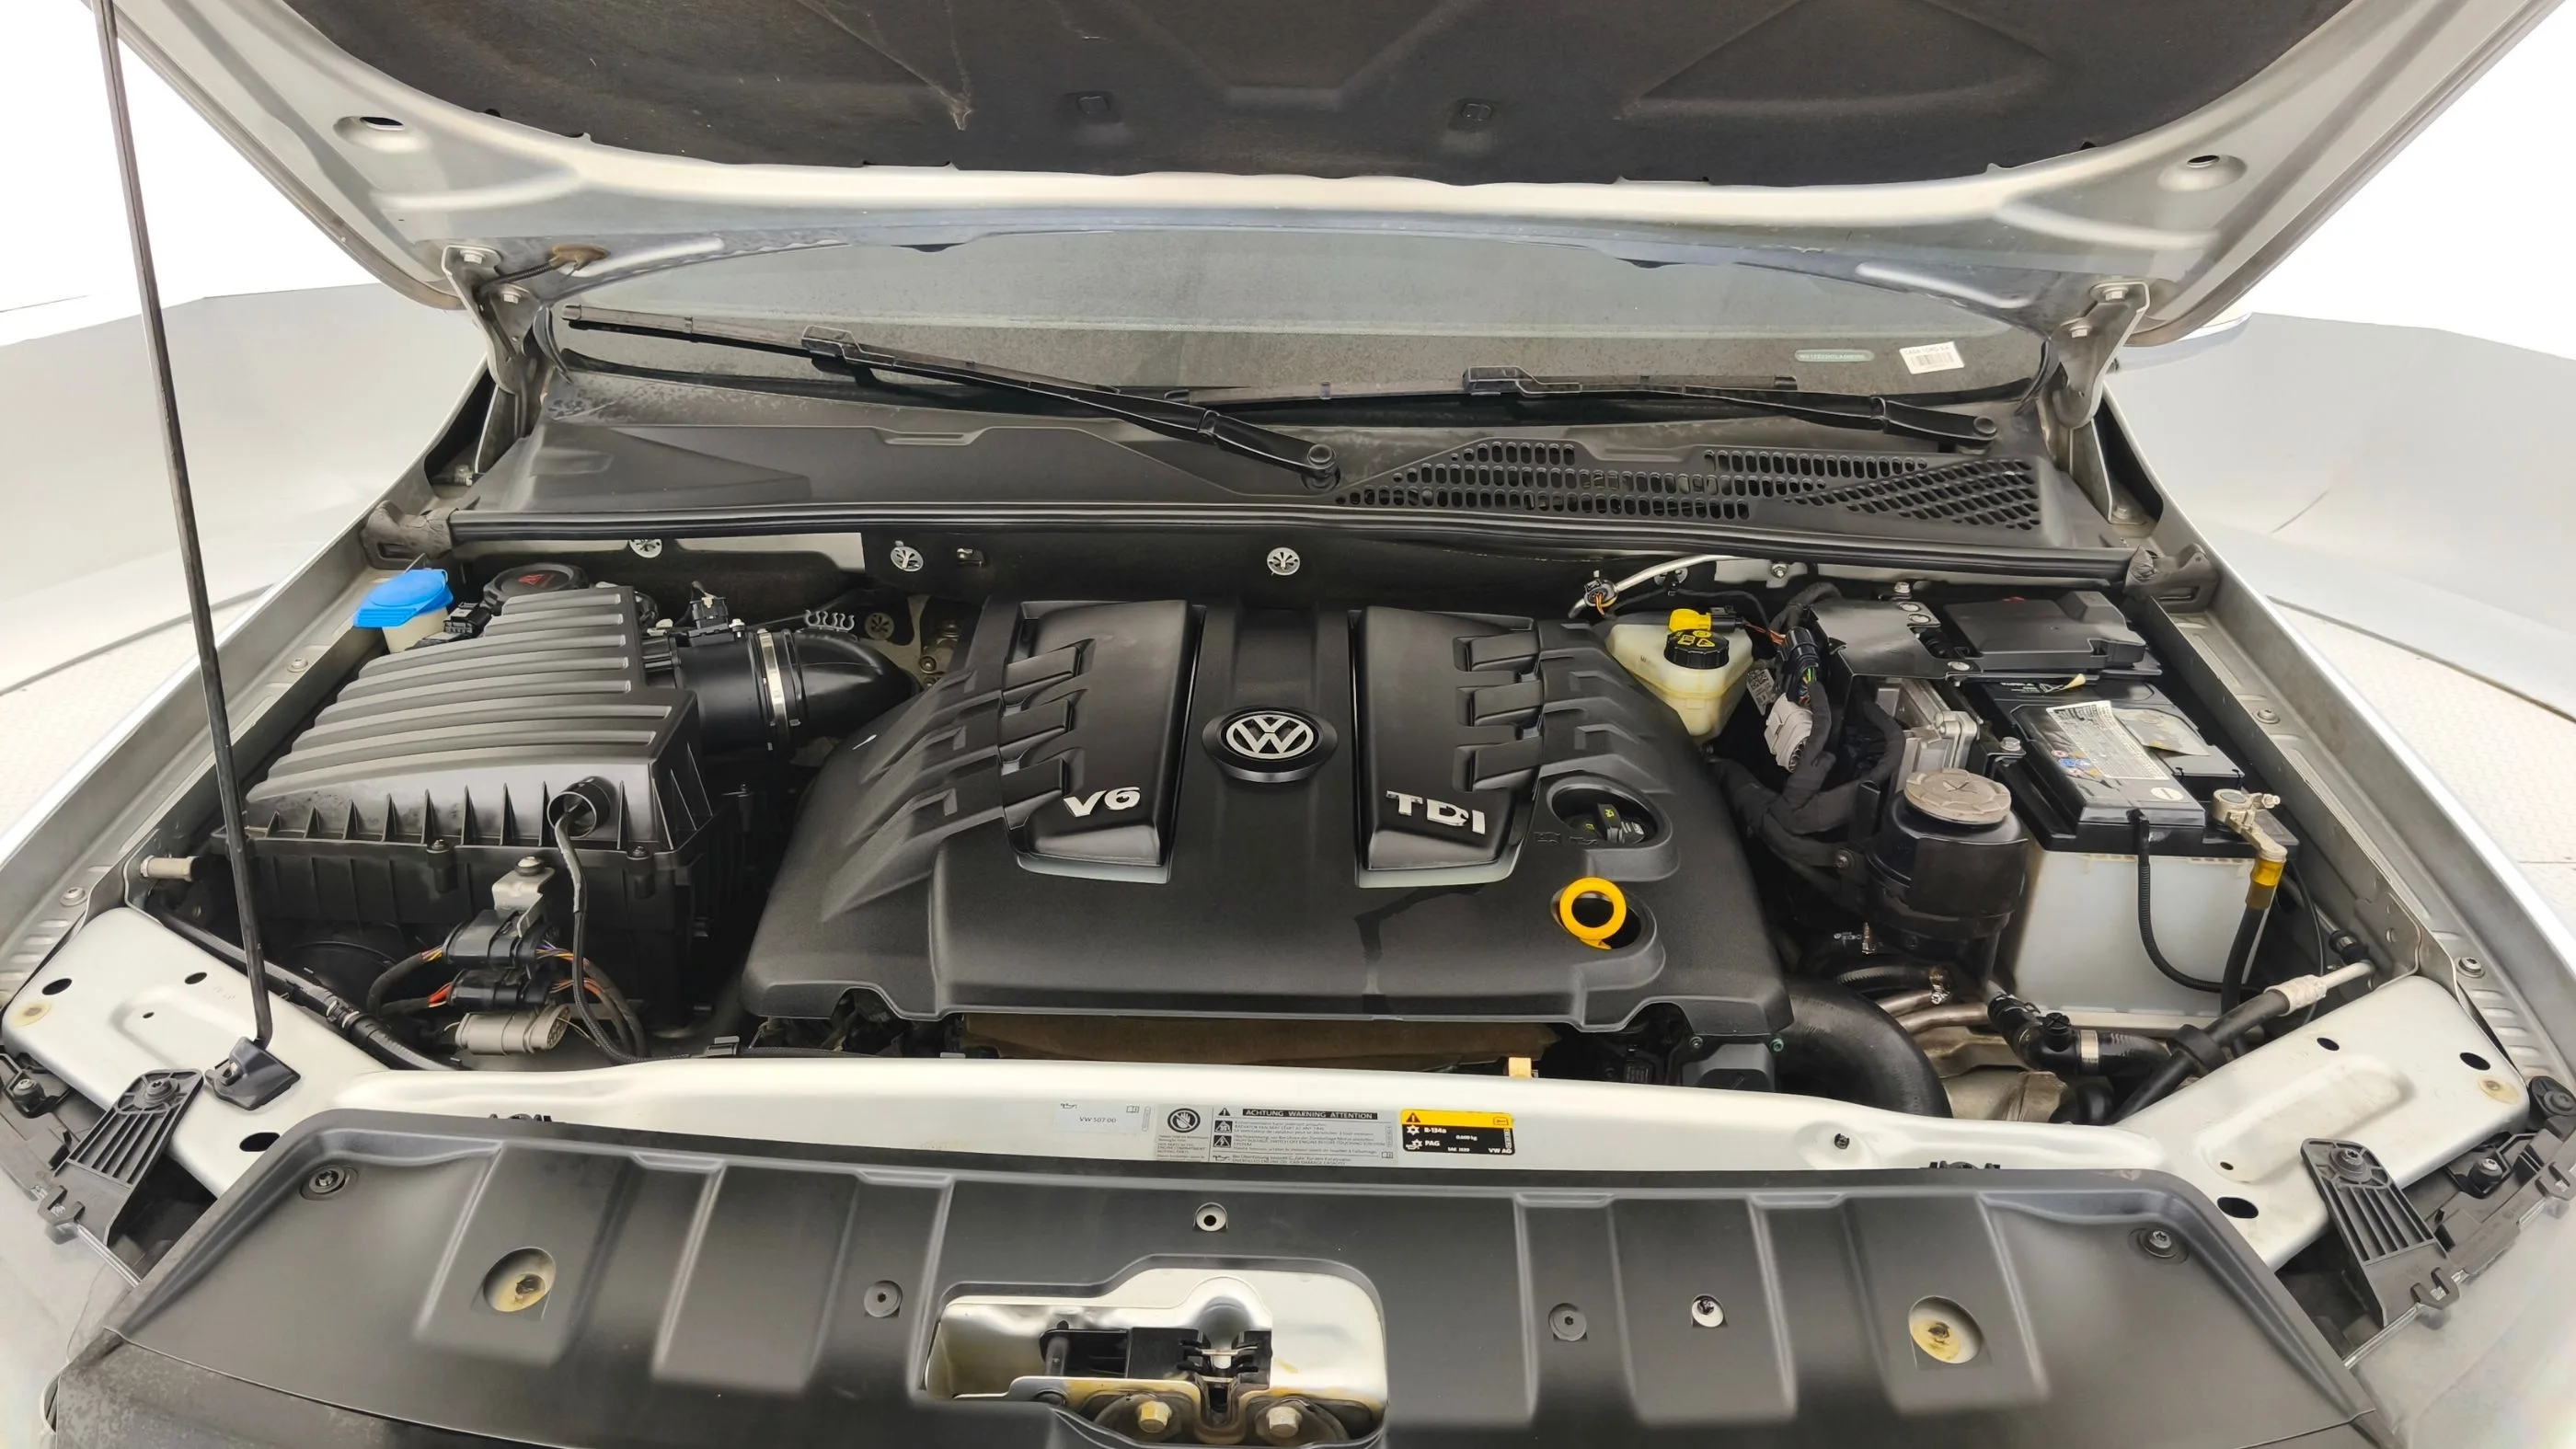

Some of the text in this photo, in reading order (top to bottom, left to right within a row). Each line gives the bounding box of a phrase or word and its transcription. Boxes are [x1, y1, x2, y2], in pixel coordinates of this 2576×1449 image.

[1226, 714, 1314, 760] VW
[1064, 787, 1141, 818] V6
[1386, 790, 1485, 835] TDI
